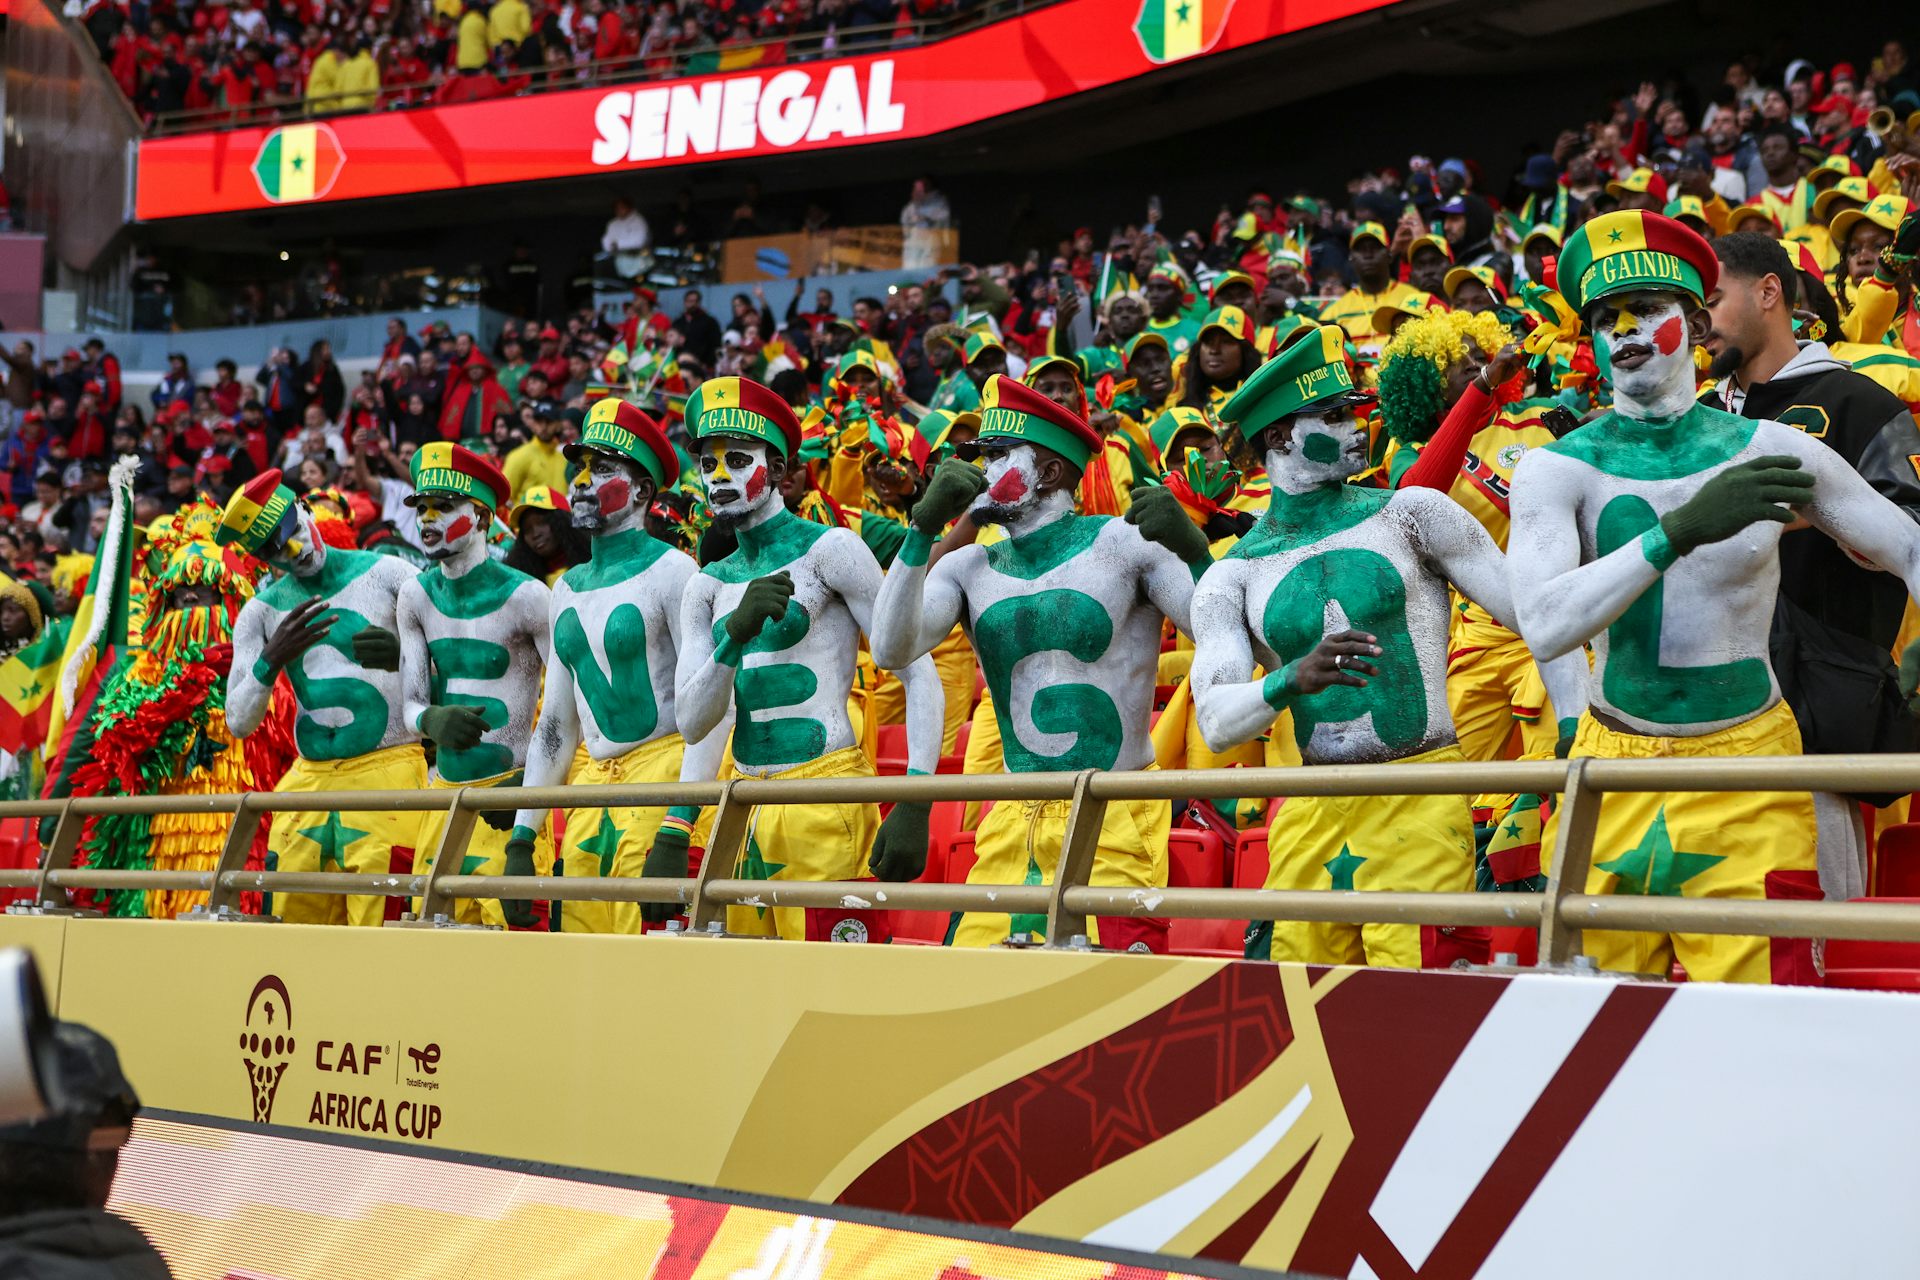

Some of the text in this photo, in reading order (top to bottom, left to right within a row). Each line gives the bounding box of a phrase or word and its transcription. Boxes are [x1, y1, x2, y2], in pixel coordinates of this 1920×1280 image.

[591, 59, 905, 165] SENEGAL
[1602, 251, 1682, 284] GAINDE
[1295, 366, 1330, 401] 12eme
[708, 408, 767, 435] GAINDE
[980, 409, 1028, 434] AINDE
[422, 468, 473, 493] GAINDE
[250, 491, 289, 538] GAINDE
[316, 1041, 382, 1075] CAF
[406, 1078, 439, 1091] TotalEnergies
[308, 1091, 442, 1139] AFRICA CUP
